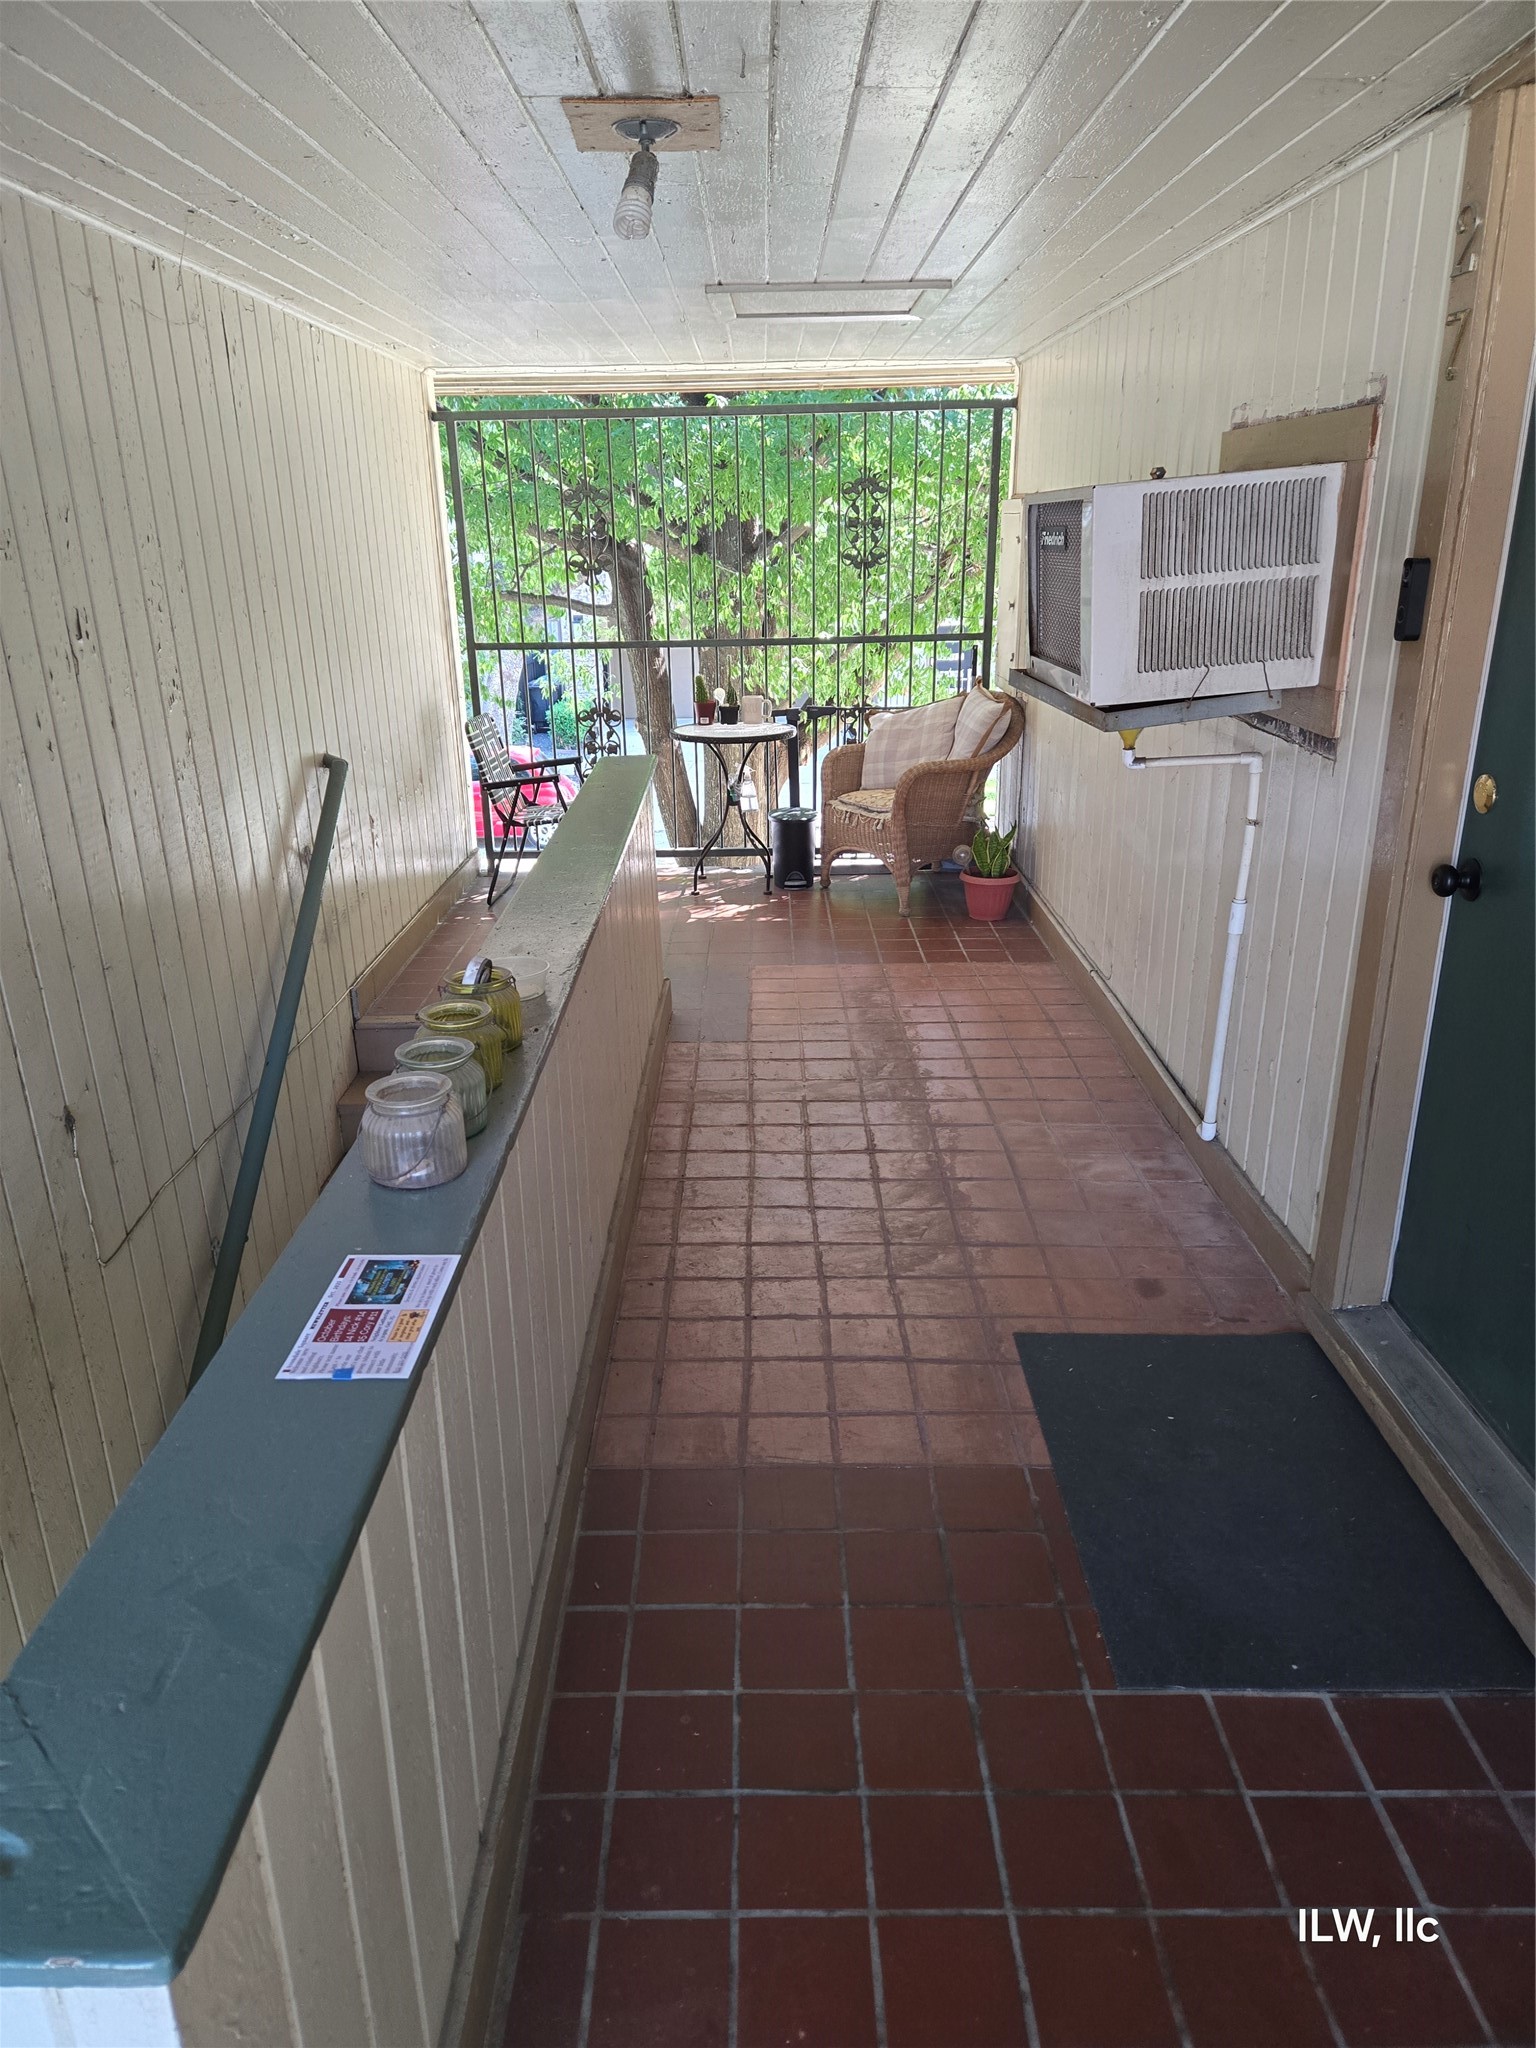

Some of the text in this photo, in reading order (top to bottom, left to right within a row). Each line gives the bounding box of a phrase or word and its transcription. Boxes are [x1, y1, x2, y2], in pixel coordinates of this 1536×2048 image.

[1040, 531, 1064, 546] Friedrich
[309, 1302, 329, 1329] NEWSLETTER
[346, 1323, 360, 1334] Nick
[354, 1311, 367, 1320] #14
[366, 1311, 379, 1319] #11
[315, 1319, 337, 1341] October
[359, 1322, 375, 1334] Cory
